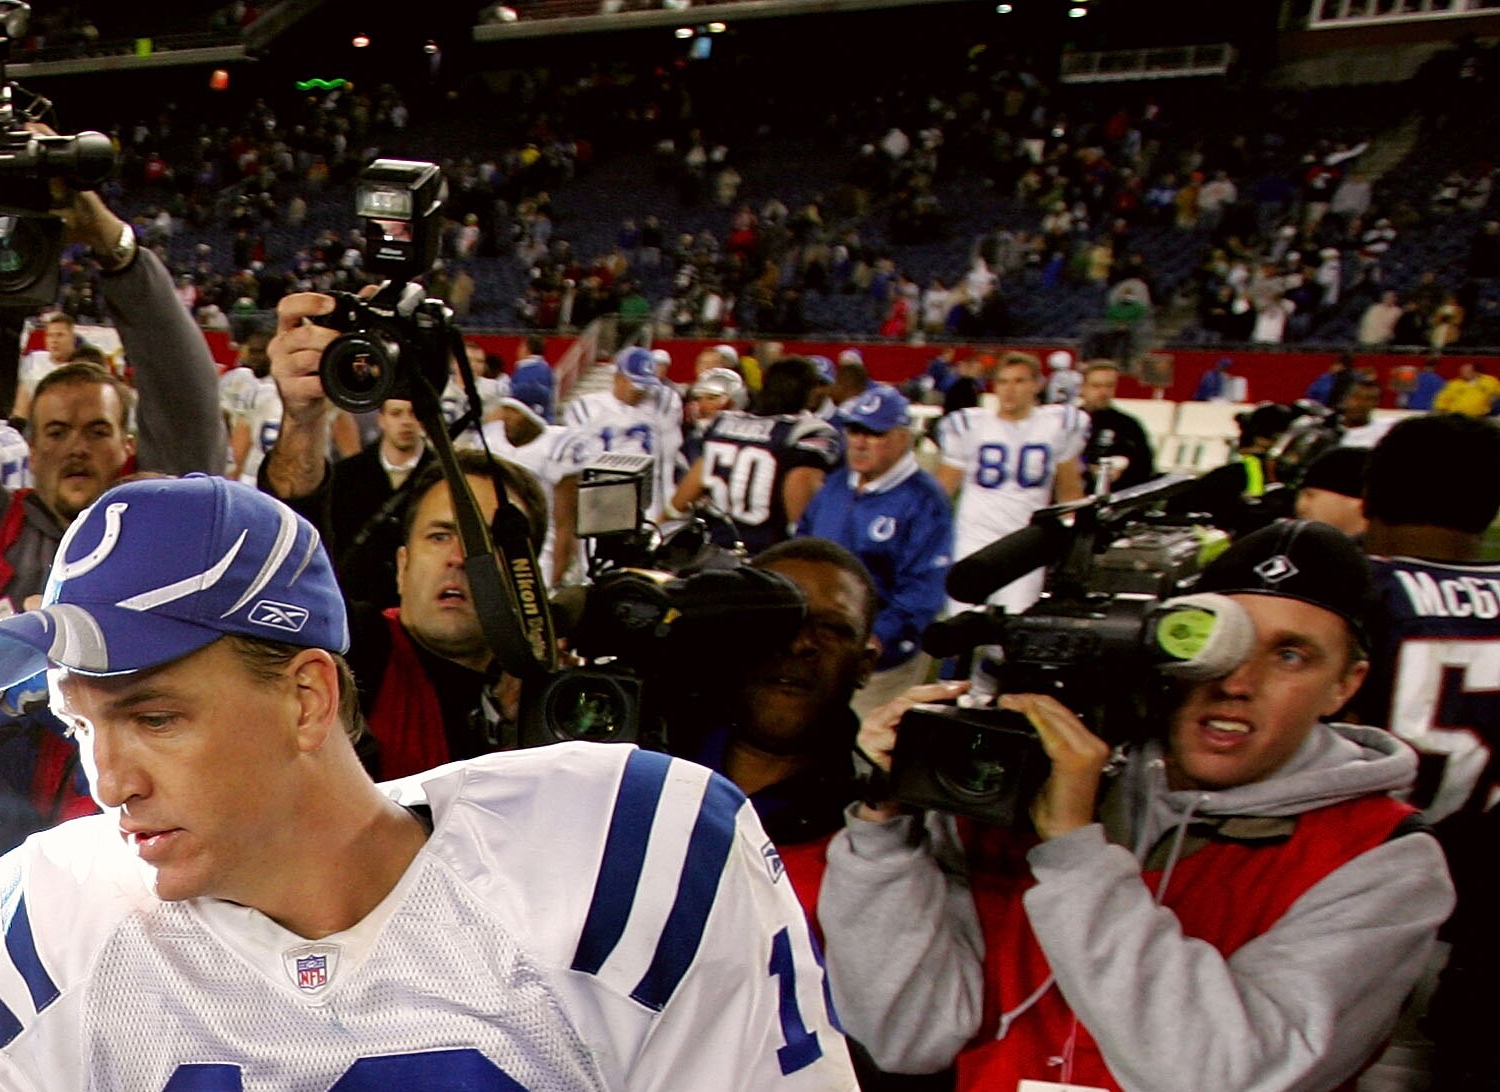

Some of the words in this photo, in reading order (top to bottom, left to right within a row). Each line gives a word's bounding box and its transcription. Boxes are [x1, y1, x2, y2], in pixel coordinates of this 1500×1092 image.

[701, 440, 778, 526] 50
[975, 443, 1052, 489] 80
[511, 557, 540, 616] Nikon
[1390, 636, 1500, 826] 5
